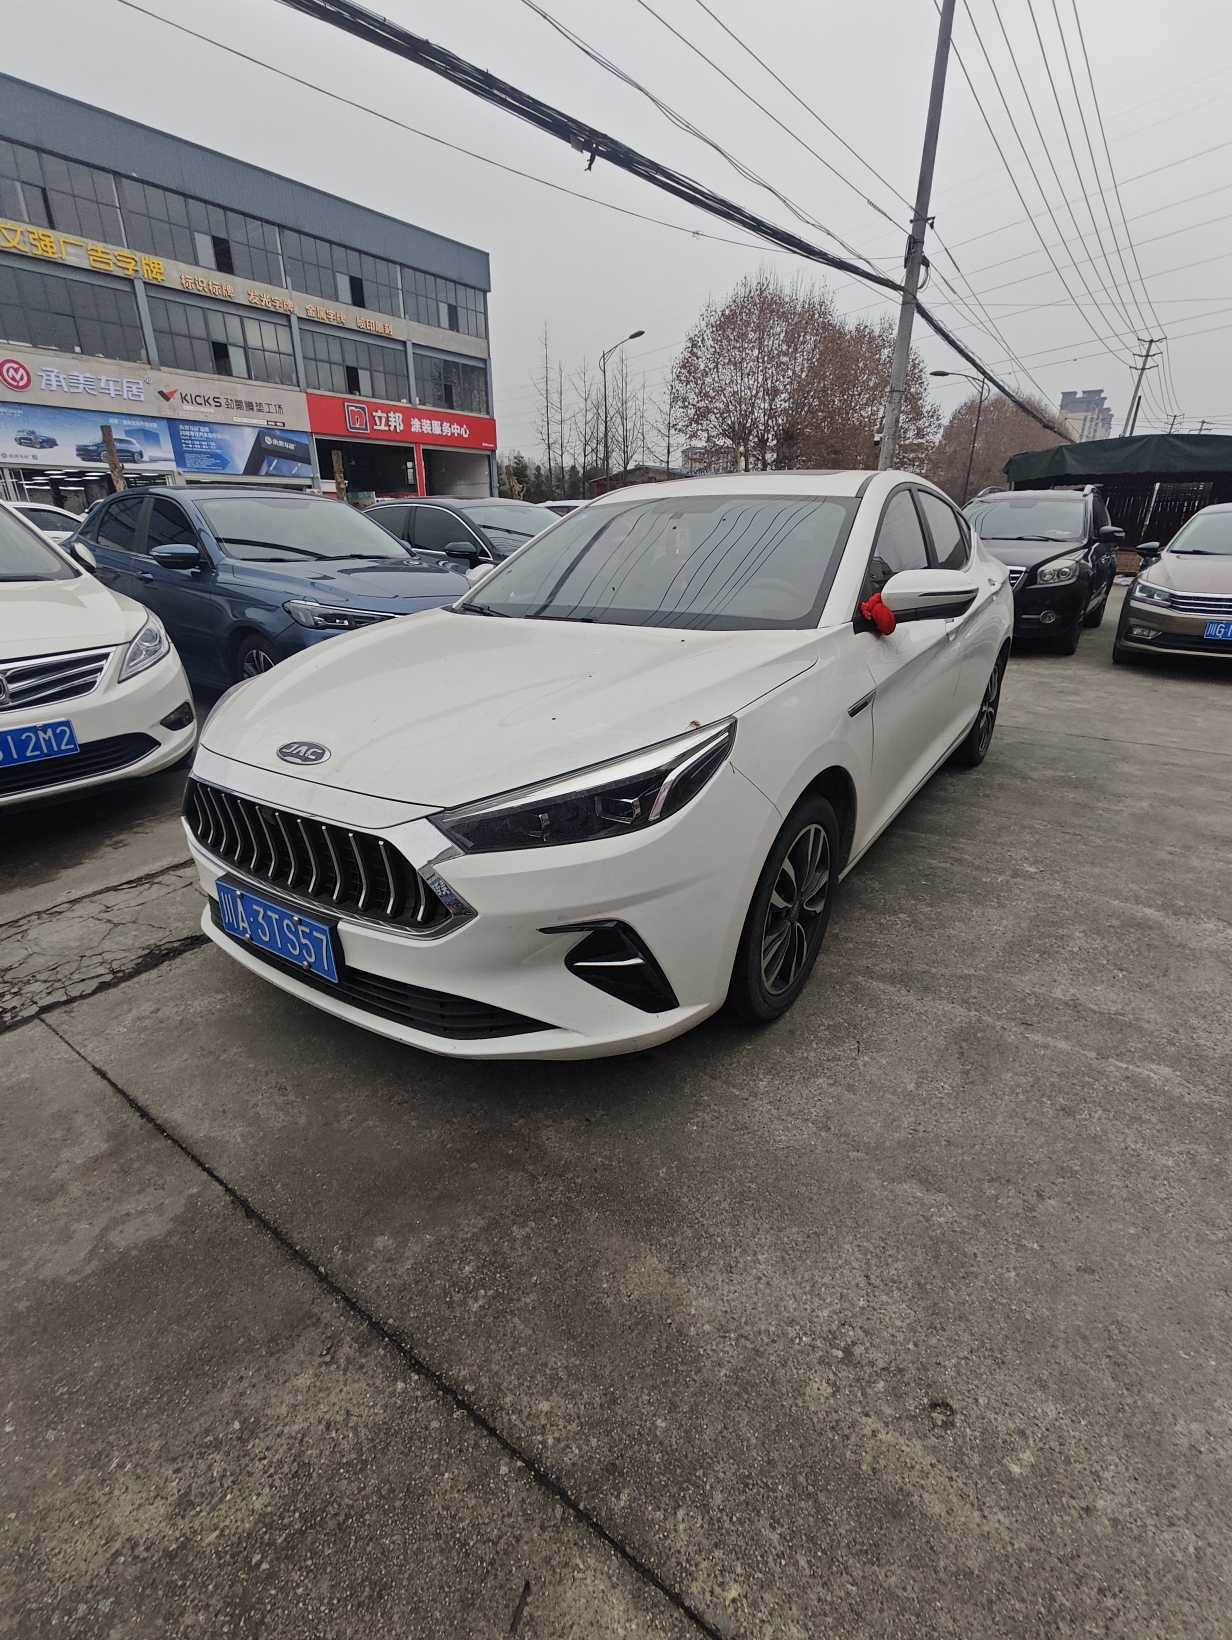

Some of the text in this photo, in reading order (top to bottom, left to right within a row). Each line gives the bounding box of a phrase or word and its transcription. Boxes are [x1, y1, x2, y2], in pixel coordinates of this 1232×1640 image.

[0, 223, 166, 283] 文强广告字牌
[38, 367, 145, 402] 承美车居
[180, 392, 222, 408] KICKS
[372, 410, 470, 438] 立邦 涂装服务中心
[281, 744, 323, 760] JAC
